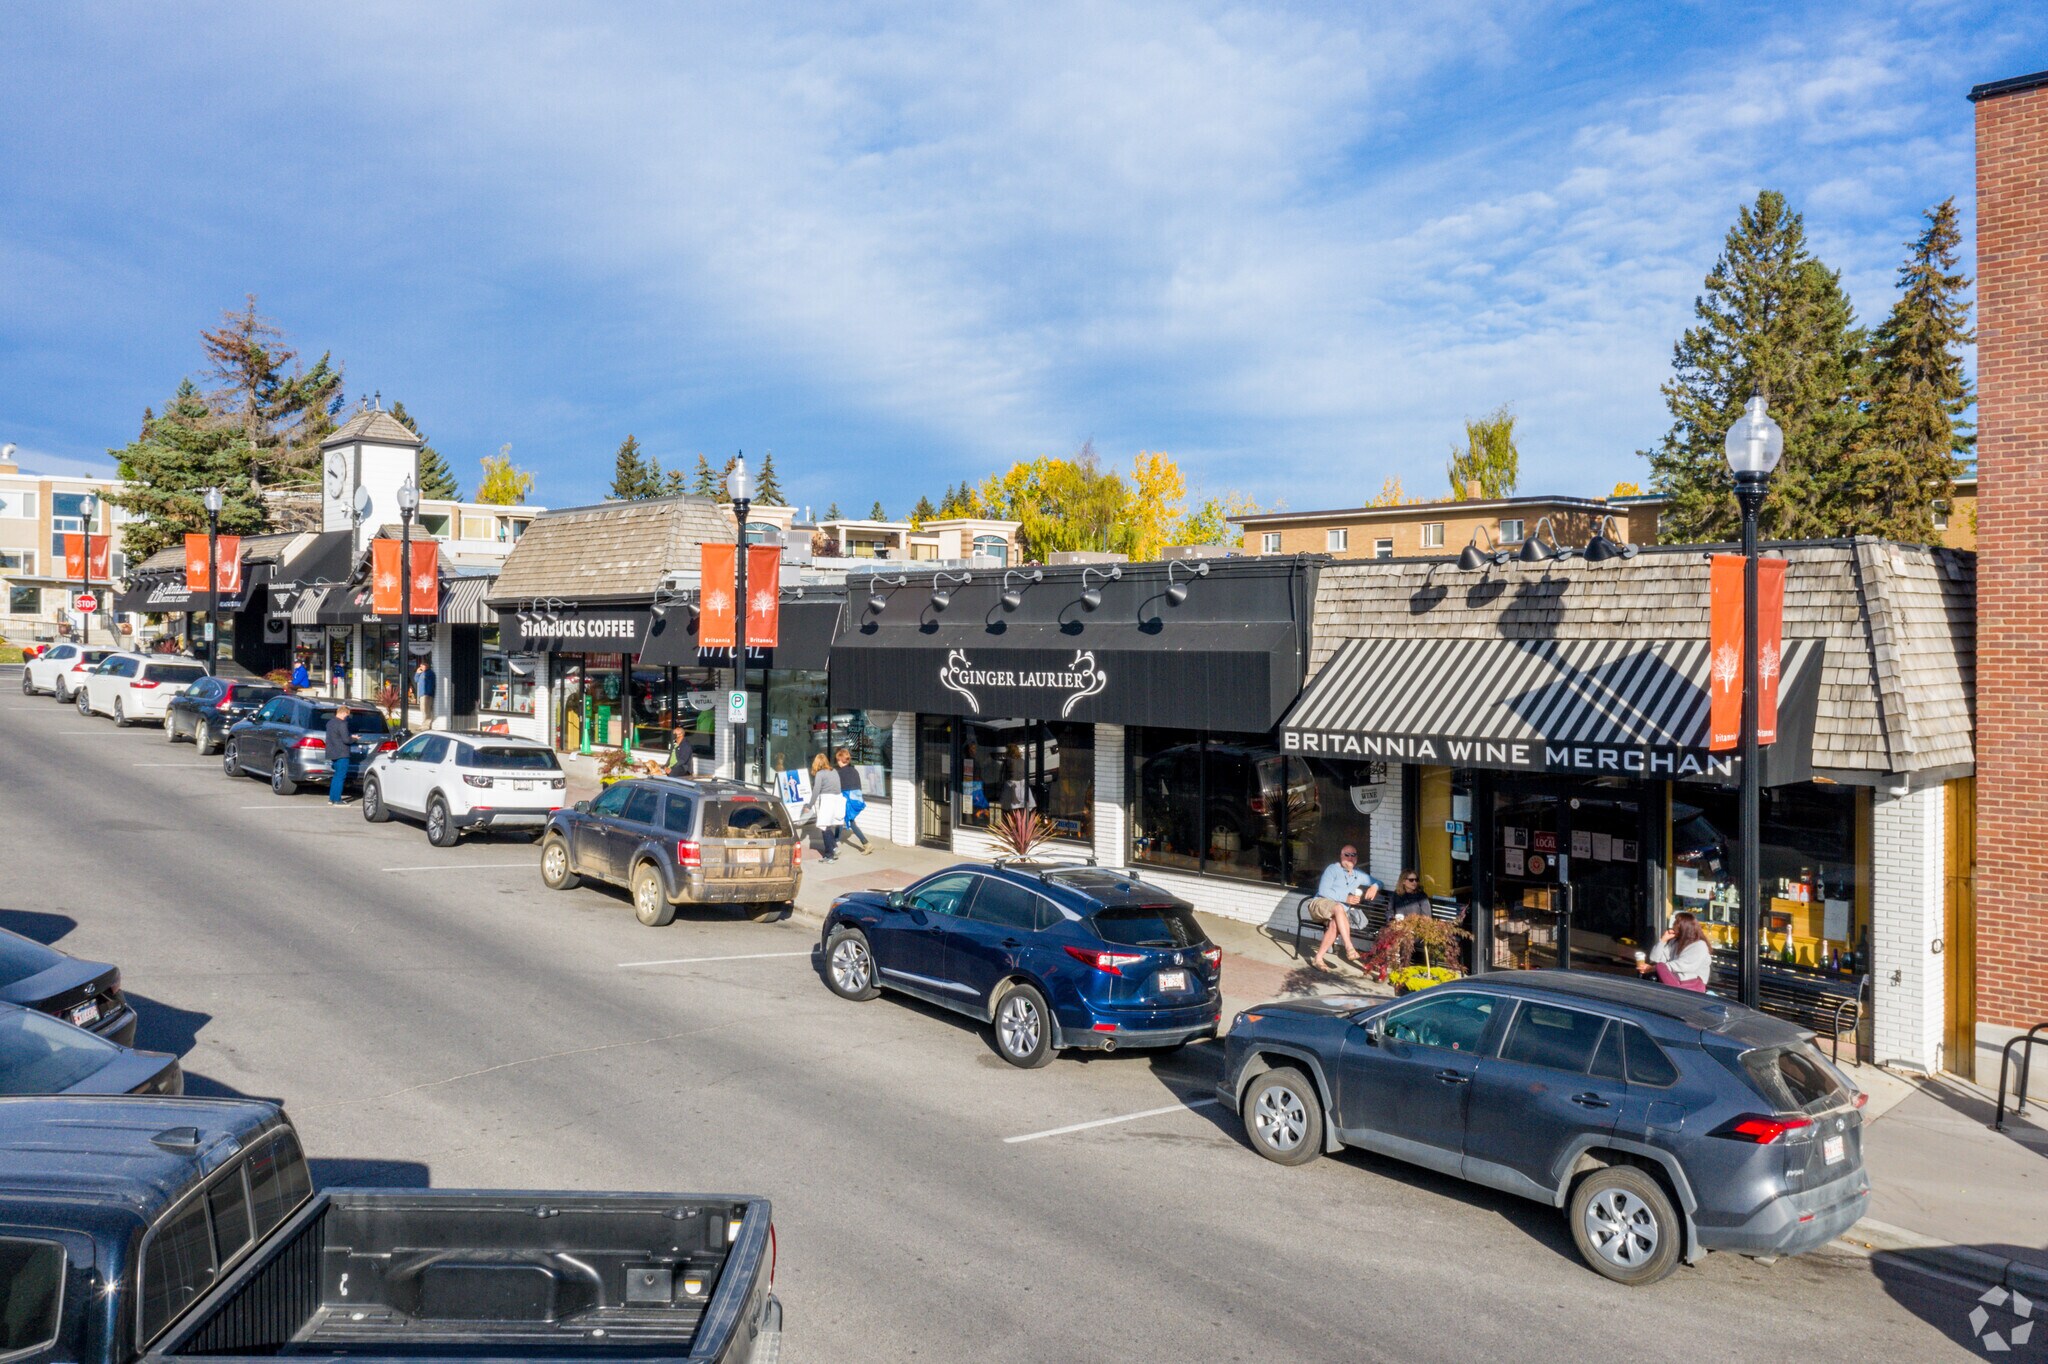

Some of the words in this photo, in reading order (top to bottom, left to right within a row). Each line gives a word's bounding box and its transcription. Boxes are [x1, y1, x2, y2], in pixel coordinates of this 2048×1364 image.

[76, 600, 96, 608] STOP
[520, 620, 586, 638] STARBUCKS
[587, 619, 635, 638] COFFEE
[958, 670, 1017, 687] GINGER
[1019, 671, 1086, 689] LAURIER
[1283, 731, 1438, 760] BRITANNIA
[1447, 740, 1531, 765] WINE
[1361, 791, 1378, 799] WINE
[1535, 839, 1557, 849] LOCAL
